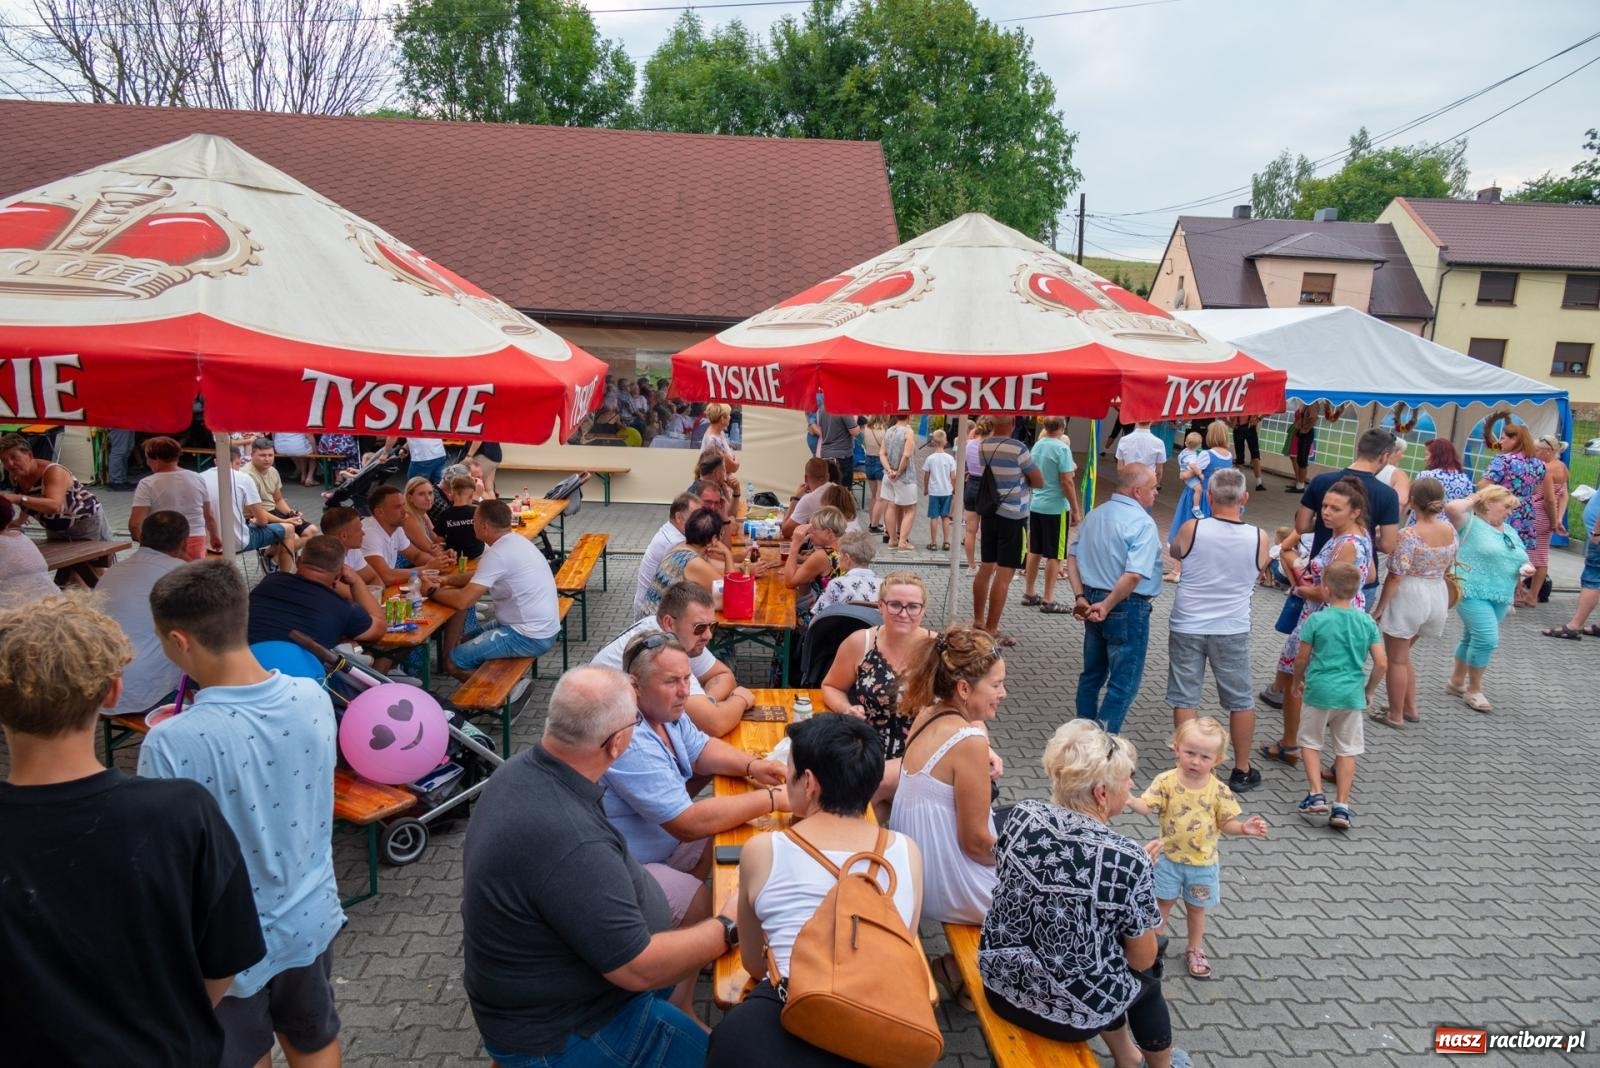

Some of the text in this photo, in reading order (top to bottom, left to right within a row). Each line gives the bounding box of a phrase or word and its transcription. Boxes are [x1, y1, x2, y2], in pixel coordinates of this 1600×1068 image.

[302, 368, 495, 435] TYSKIE
[702, 360, 784, 404] TYSKIE
[887, 369, 1048, 412] TYSKIE
[1161, 373, 1255, 417] TYSKIE
